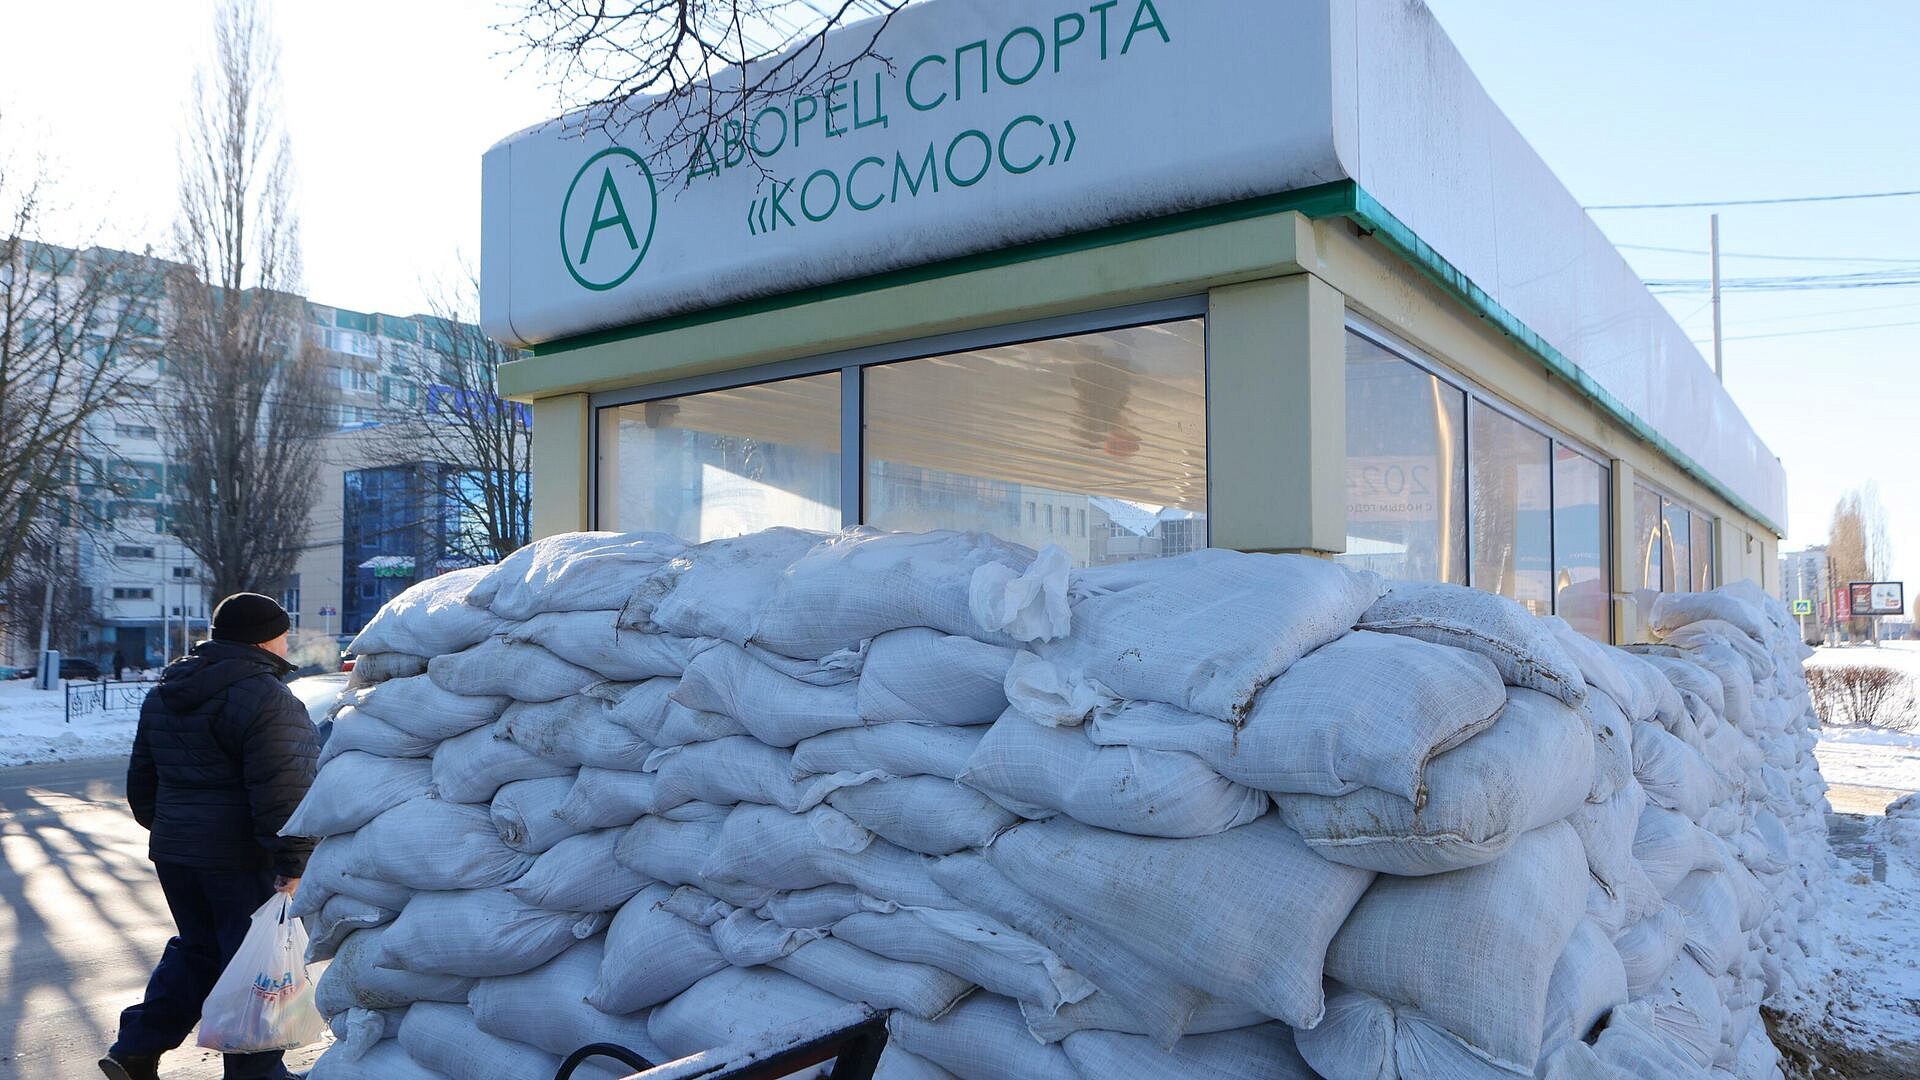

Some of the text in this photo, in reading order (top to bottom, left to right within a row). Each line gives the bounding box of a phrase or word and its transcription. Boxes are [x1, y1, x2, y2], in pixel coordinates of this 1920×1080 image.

[686, 0, 1171, 185] ДВОРЕЦ СПОРТА
[747, 115, 1076, 236] «КОСМОС»
